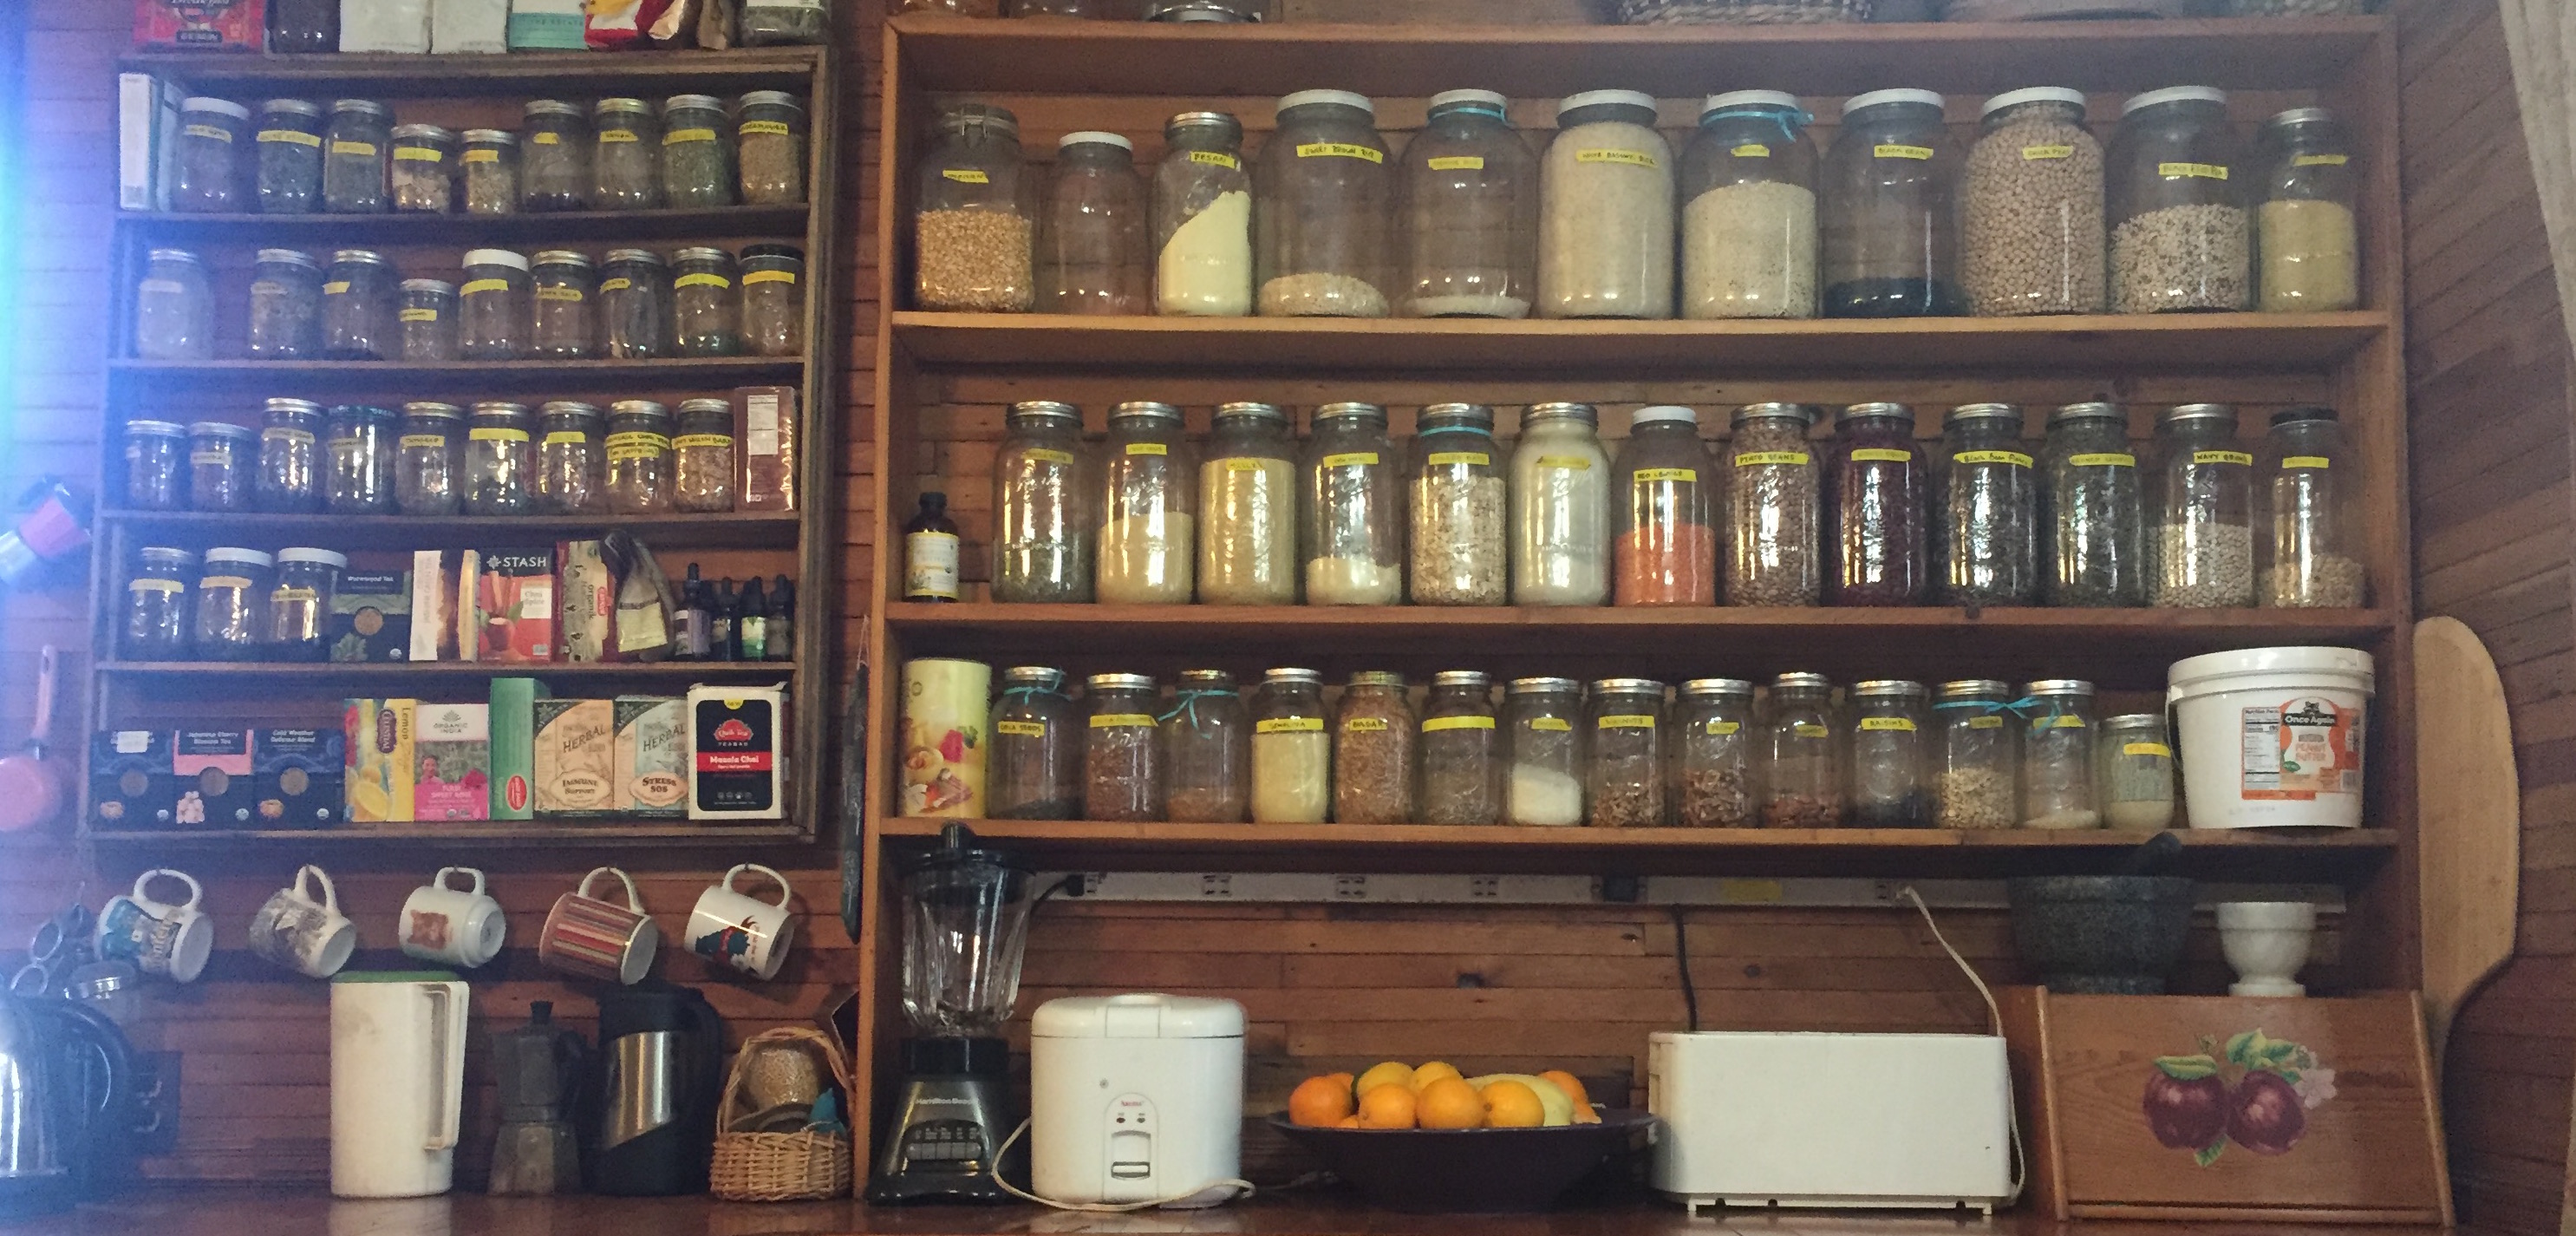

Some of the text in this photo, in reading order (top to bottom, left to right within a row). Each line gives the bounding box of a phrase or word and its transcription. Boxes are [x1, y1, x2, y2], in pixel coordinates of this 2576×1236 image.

[503, 557, 546, 567] STASH
[402, 708, 411, 740] Lemon
[2284, 715, 2336, 726] Once Again
[563, 724, 606, 753] HERBAL
[642, 723, 687, 752] HERBAL
[642, 776, 677, 787] STRESS
